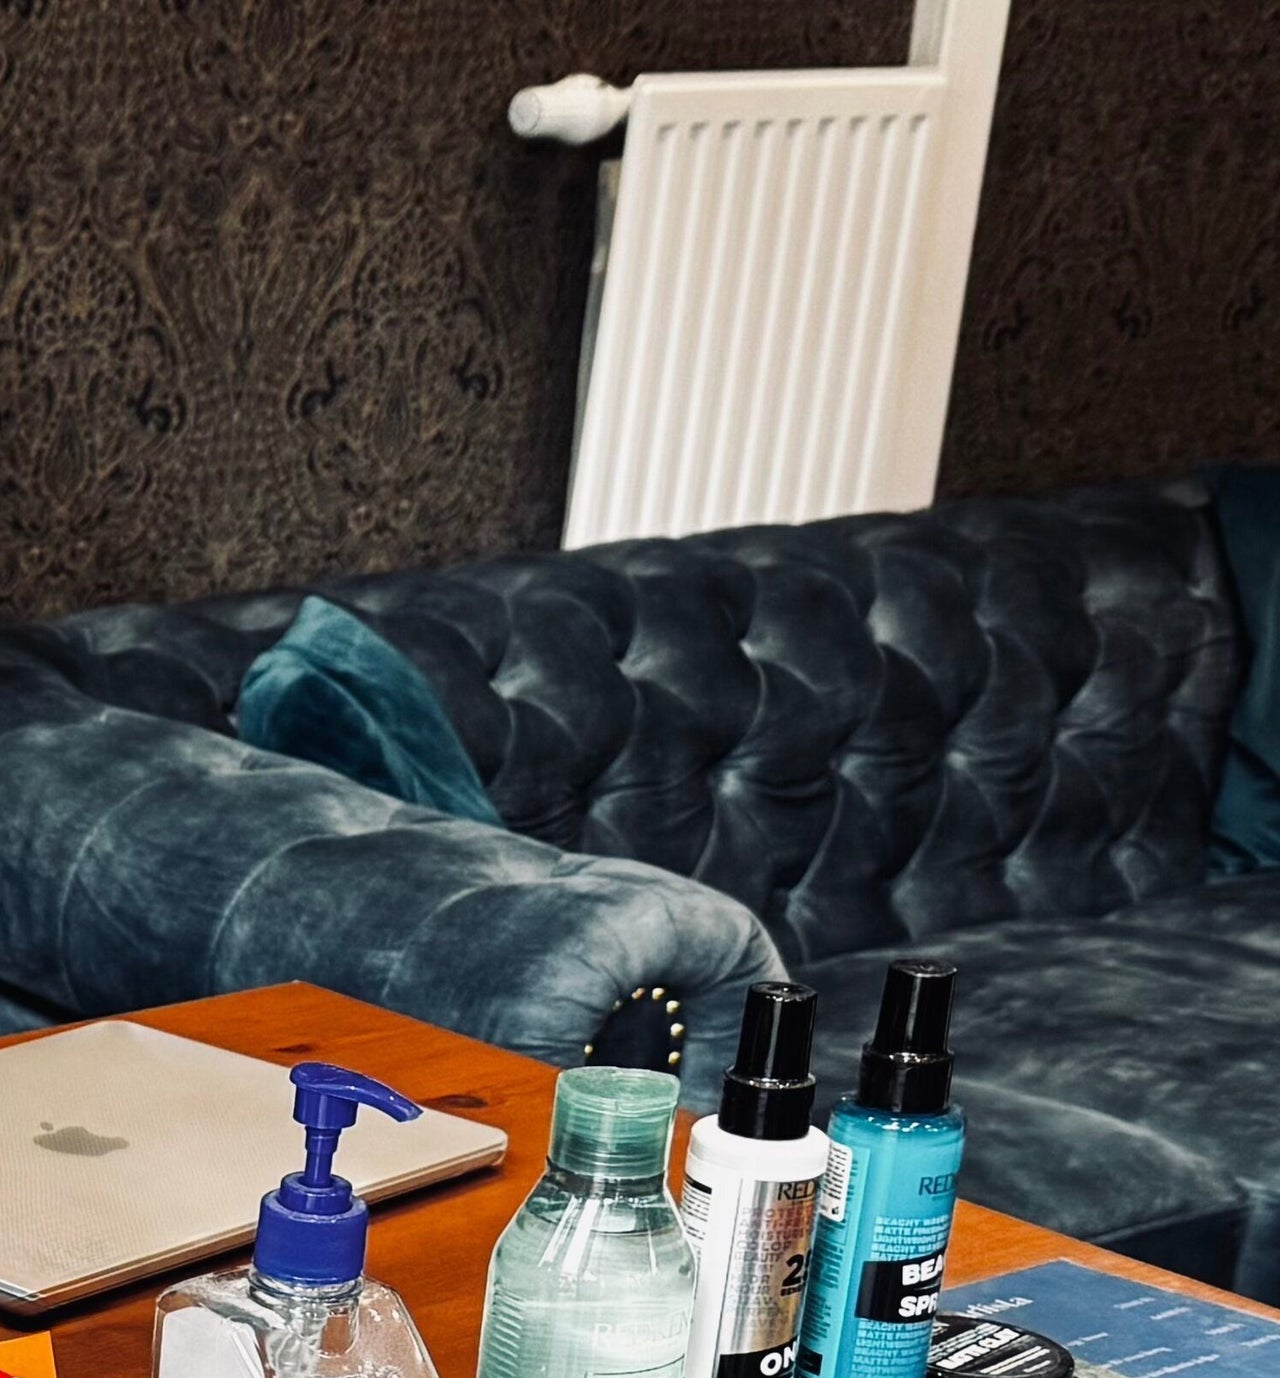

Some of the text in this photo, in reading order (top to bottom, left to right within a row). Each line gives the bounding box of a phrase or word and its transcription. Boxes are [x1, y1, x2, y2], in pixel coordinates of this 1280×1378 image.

[777, 1181, 819, 1201] RED
[918, 1173, 956, 1196] RED
[901, 1254, 944, 1287] BEA
[898, 1292, 938, 1319] SPR
[760, 1341, 798, 1377] ON
